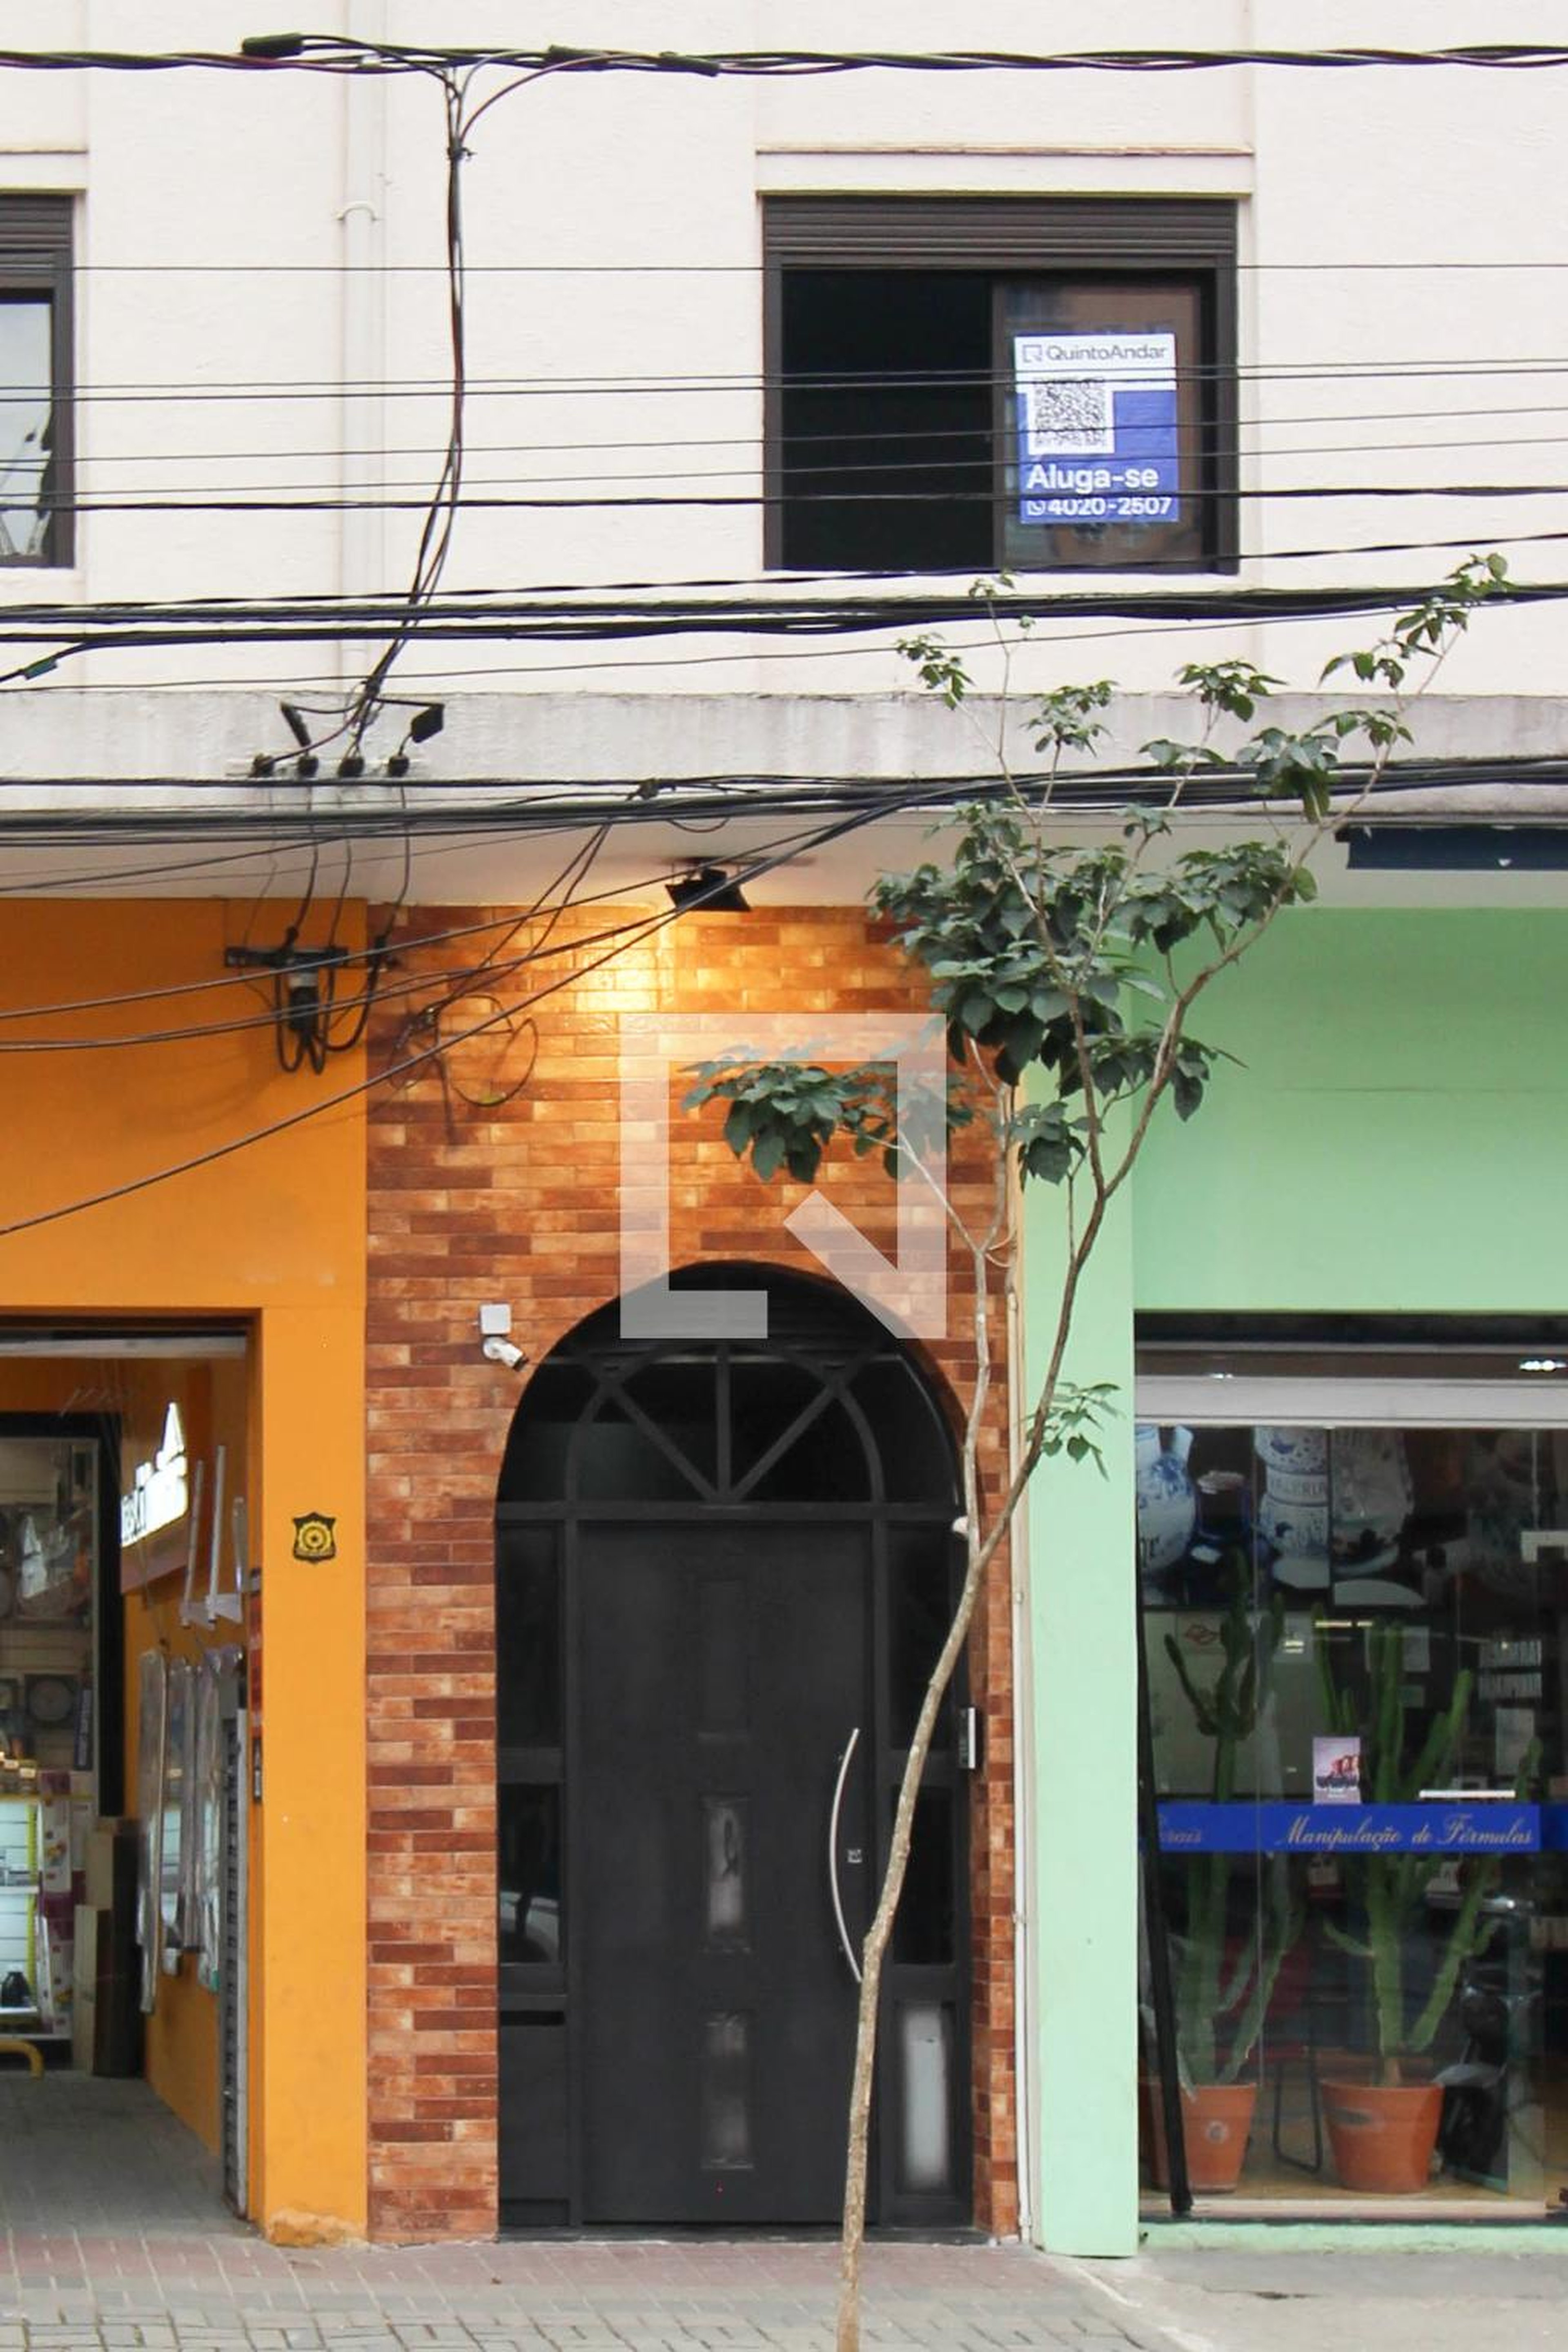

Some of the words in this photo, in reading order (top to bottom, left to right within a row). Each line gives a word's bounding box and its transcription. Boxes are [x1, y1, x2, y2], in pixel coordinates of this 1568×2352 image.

[1046, 345, 1166, 361] QuintoAndar
[1027, 464, 1159, 493] Aluga-se
[1047, 497, 1171, 515] 4020-2507
[1275, 1815, 1401, 1851] Manipulação
[1412, 1824, 1432, 1844] de
